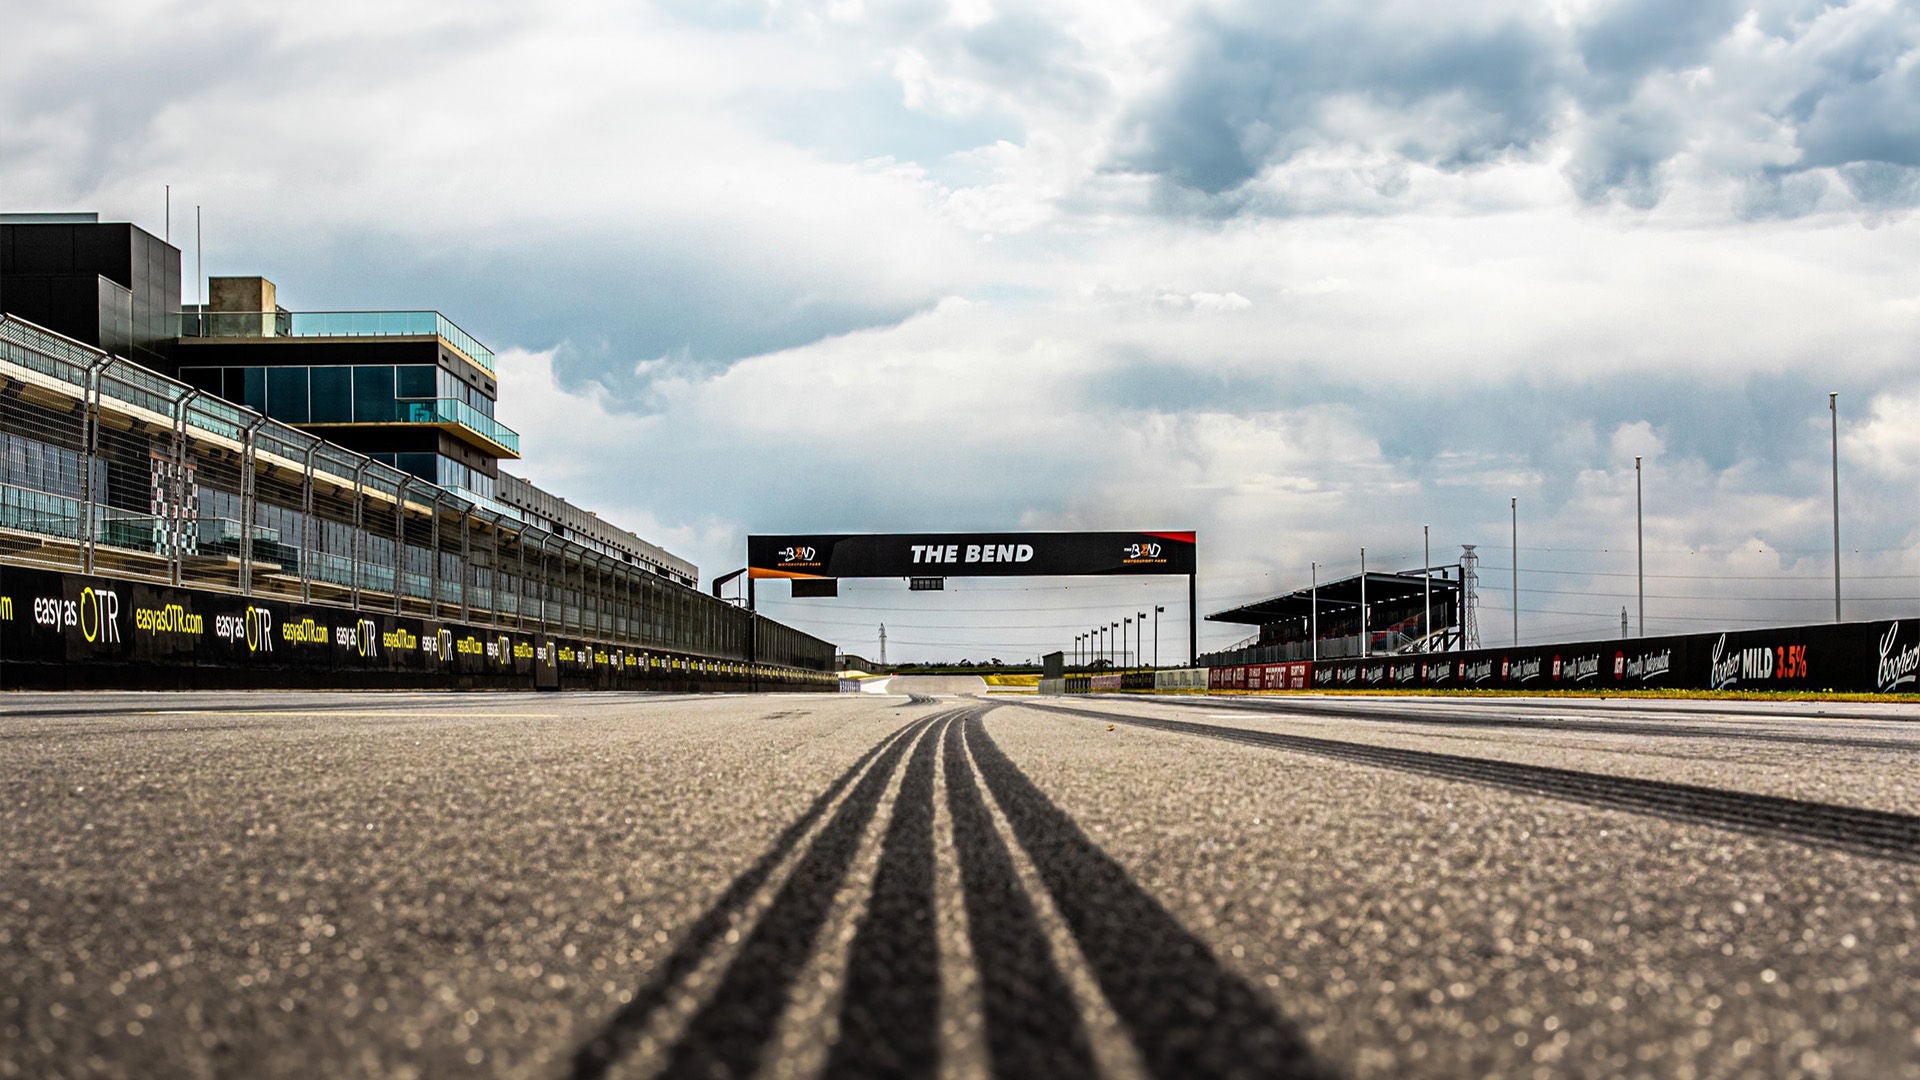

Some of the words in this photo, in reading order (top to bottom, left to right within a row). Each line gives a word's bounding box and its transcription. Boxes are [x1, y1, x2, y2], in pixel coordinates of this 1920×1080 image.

[910, 544, 958, 563] THE
[964, 543, 1034, 563] BEND
[80, 587, 121, 644] OTR
[135, 603, 204, 636] easyasOTR.com
[245, 606, 273, 652] OTR
[282, 618, 329, 646] easyasOTR.com
[357, 618, 378, 657] OTR
[1742, 647, 1773, 679] MILD
[1776, 645, 1807, 679] 3.5%
